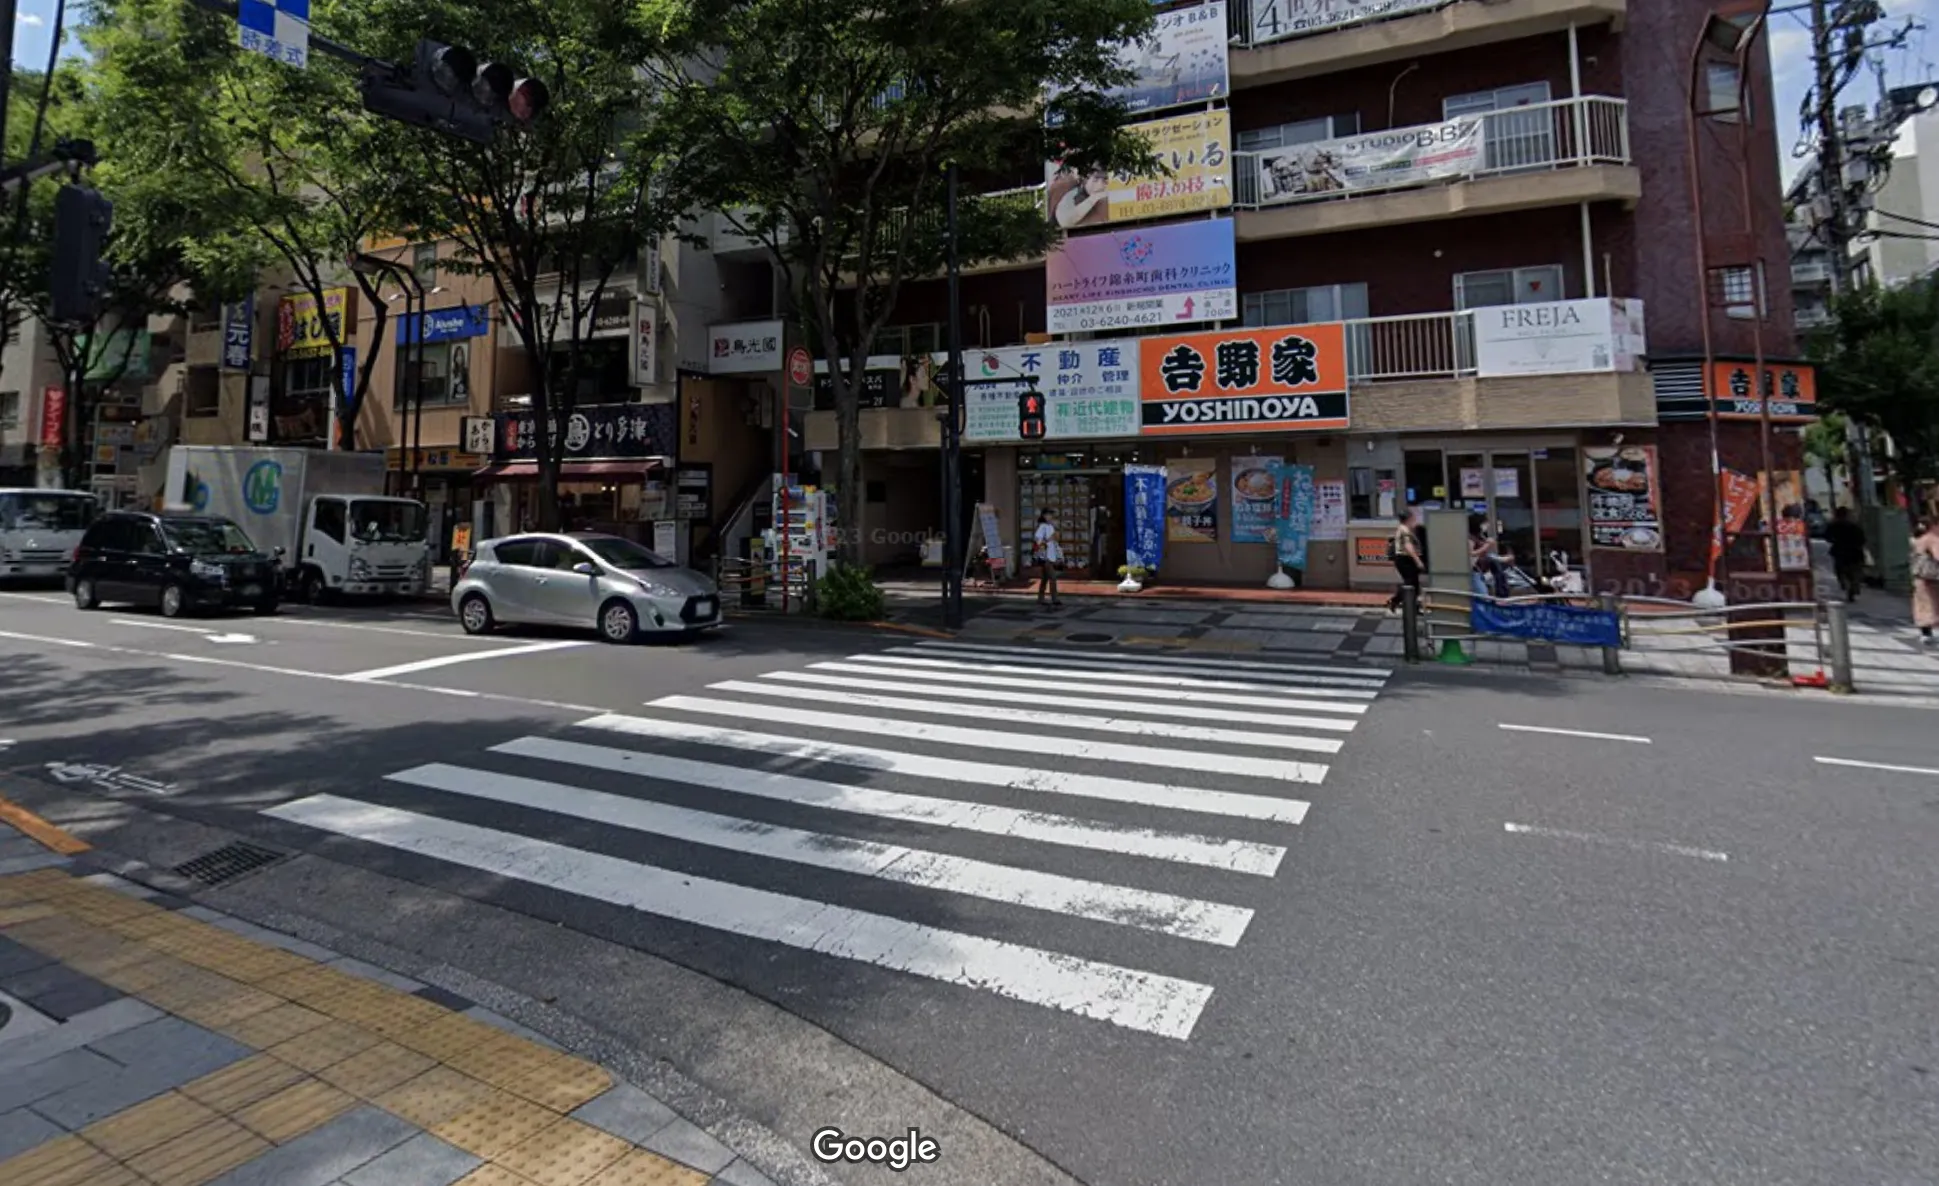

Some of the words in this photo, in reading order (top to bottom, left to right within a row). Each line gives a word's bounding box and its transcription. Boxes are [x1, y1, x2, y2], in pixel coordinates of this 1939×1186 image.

[1187, 7, 1219, 24] B&B
[242, 28, 304, 67] 時差式
[1080, 311, 1163, 329] 03-6240-4621
[1502, 306, 1581, 328] FREJA
[1057, 373, 1083, 385] 仲介
[1102, 370, 1129, 383] 管理
[1162, 397, 1320, 423] YOSHINOYA
